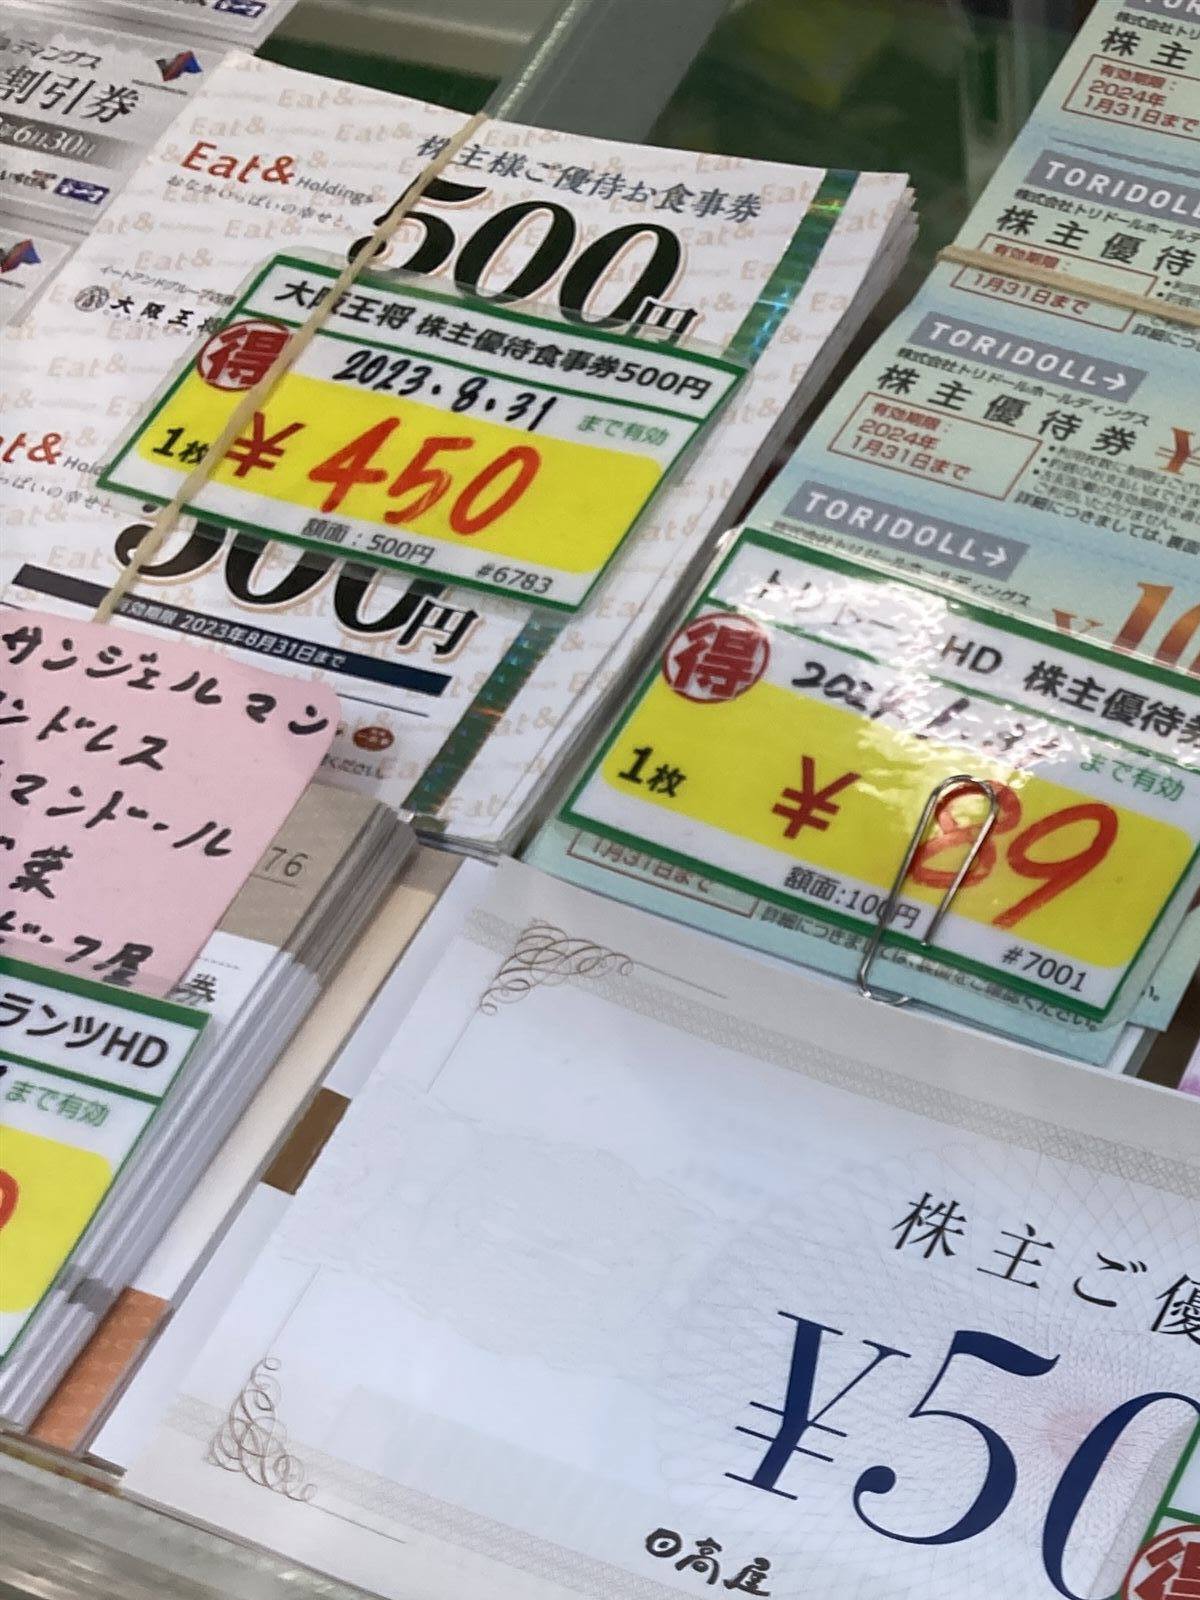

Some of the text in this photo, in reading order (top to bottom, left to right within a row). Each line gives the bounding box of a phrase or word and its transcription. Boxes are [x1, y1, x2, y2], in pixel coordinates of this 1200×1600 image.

[1082, 94, 1200, 133] 1月31日まで
[1087, 79, 1168, 108] 2024年
[181, 141, 294, 186] Eat&
[416, 132, 762, 224] 株主様ご優待お食事券
[973, 271, 1092, 316] 1月31日まで
[415, 313, 715, 402] 株主優待食事券500円
[928, 321, 1099, 387] TORIDOLL
[332, 349, 671, 447] 2023.8.31 まで有効
[876, 363, 1138, 456] 株主優待券
[849, 435, 973, 481] 1月31日まで
[858, 418, 941, 450] 2024年
[804, 491, 978, 562] TORIDOLL
[475, 563, 555, 596] #6783
[1, 625, 329, 737] サンジェルマン
[668, 618, 762, 699] 得
[619, 745, 688, 799] 1枚
[1075, 749, 1185, 803] まで有効
[261, 844, 309, 879] 76
[1000, 944, 1089, 995] #7001
[0, 990, 169, 1070] ランツHD
[3, 1079, 112, 1130] まで有効
